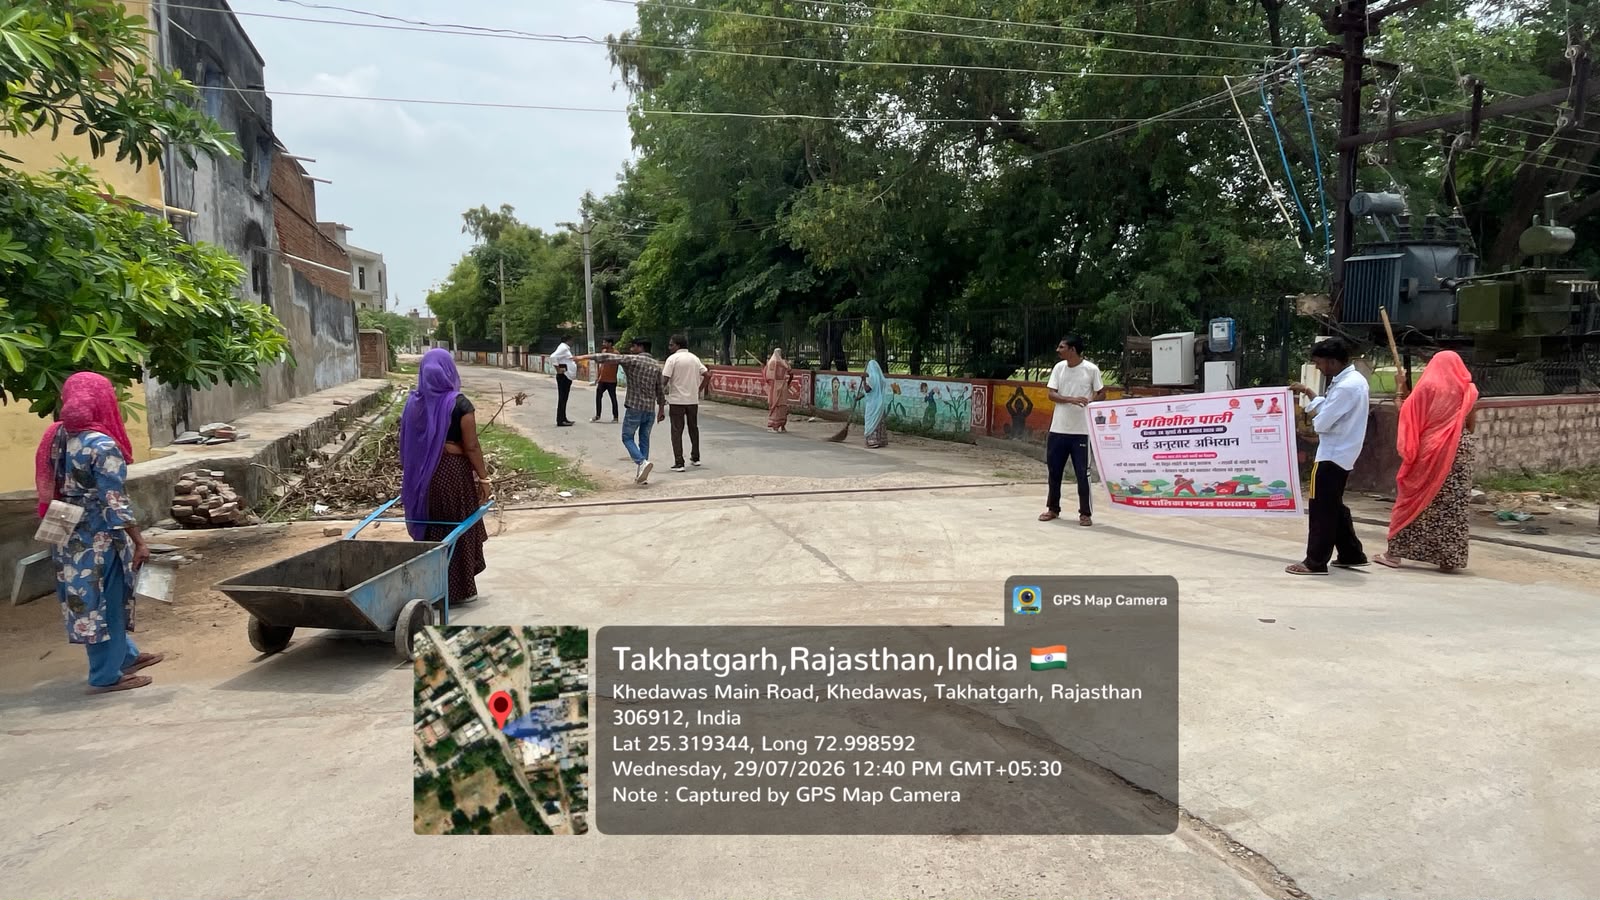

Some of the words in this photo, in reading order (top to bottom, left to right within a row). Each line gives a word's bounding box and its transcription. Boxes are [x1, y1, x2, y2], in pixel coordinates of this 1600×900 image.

[1133, 414, 1195, 429] प्रगतिशील
[1198, 411, 1235, 424] पाली
[1131, 439, 1149, 450] वार्ड
[1154, 439, 1190, 451] अनुसार
[1194, 436, 1240, 448] अभियान
[1132, 499, 1150, 507] नगर
[1150, 498, 1184, 507] पालिका
[1185, 499, 1214, 508] मण्डल
